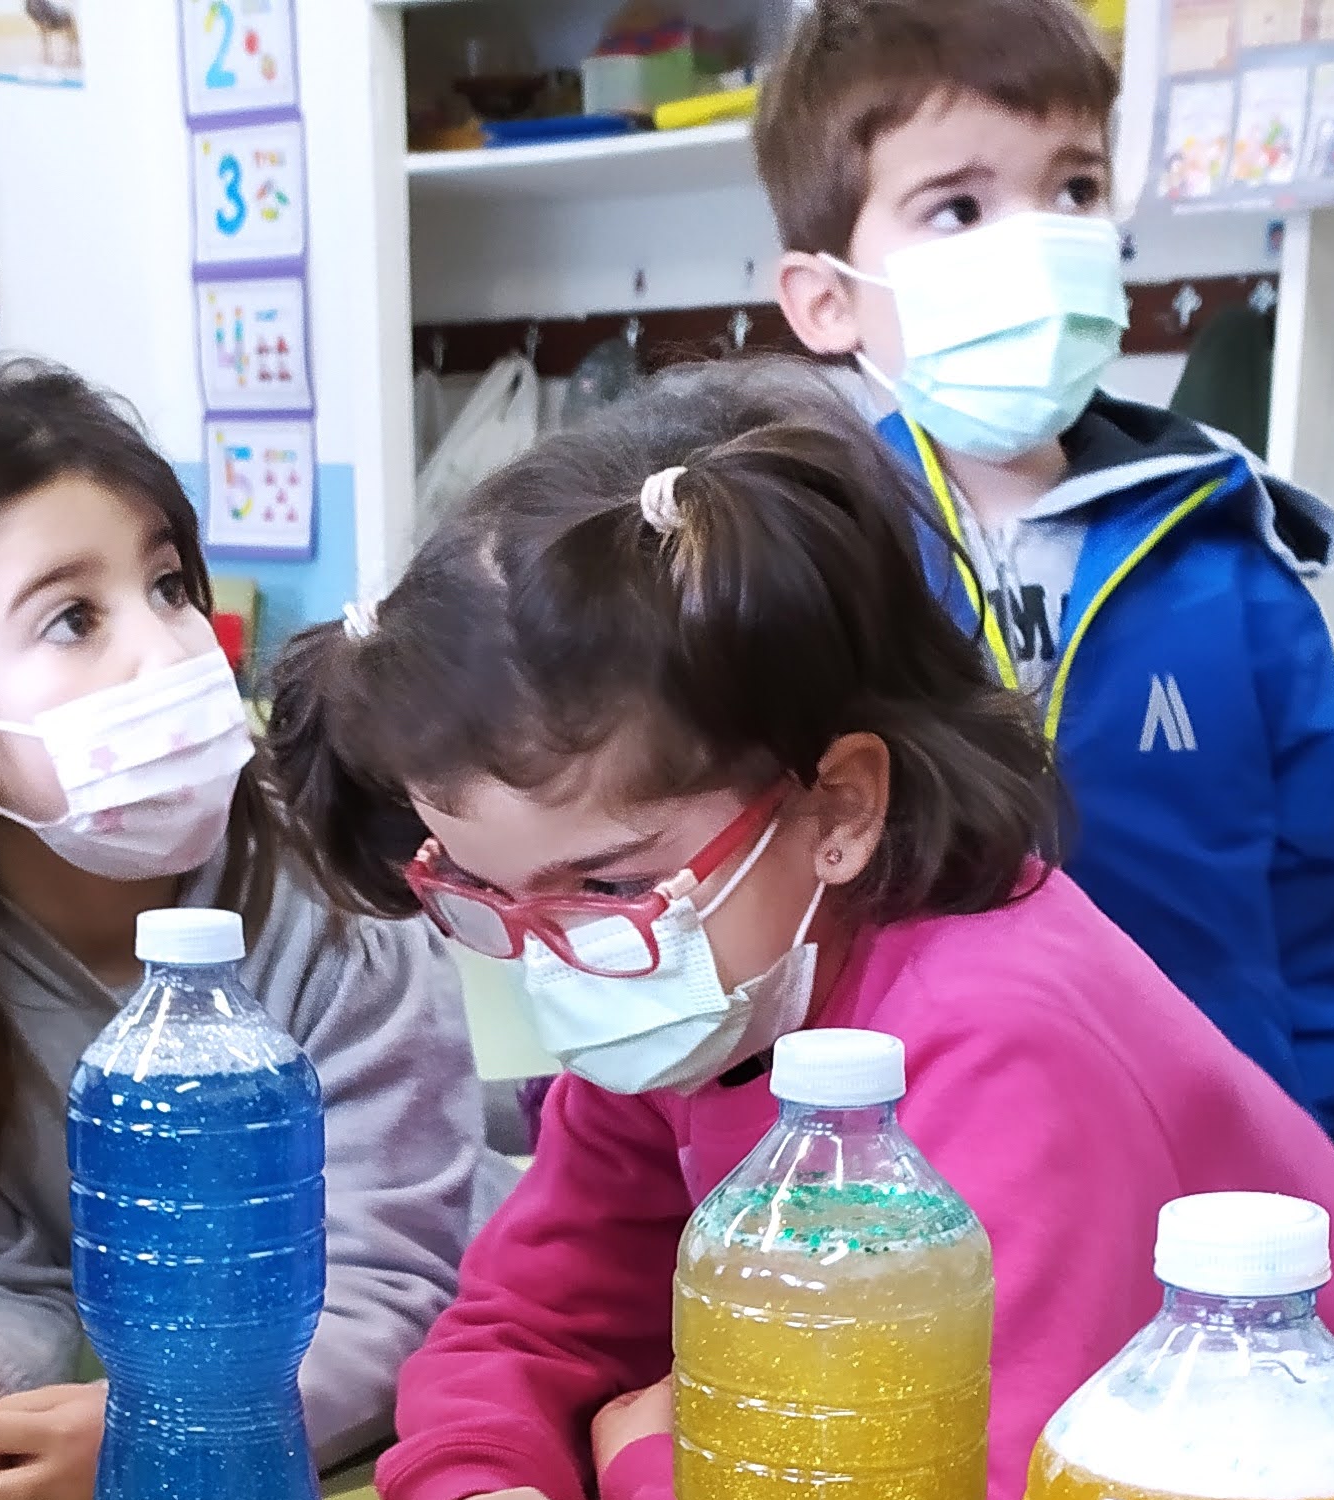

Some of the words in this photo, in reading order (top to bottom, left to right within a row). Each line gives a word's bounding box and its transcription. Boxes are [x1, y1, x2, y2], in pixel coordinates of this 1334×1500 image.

[203, 0, 237, 89] 2
[215, 153, 247, 236] 3
[223, 445, 255, 521] 5
